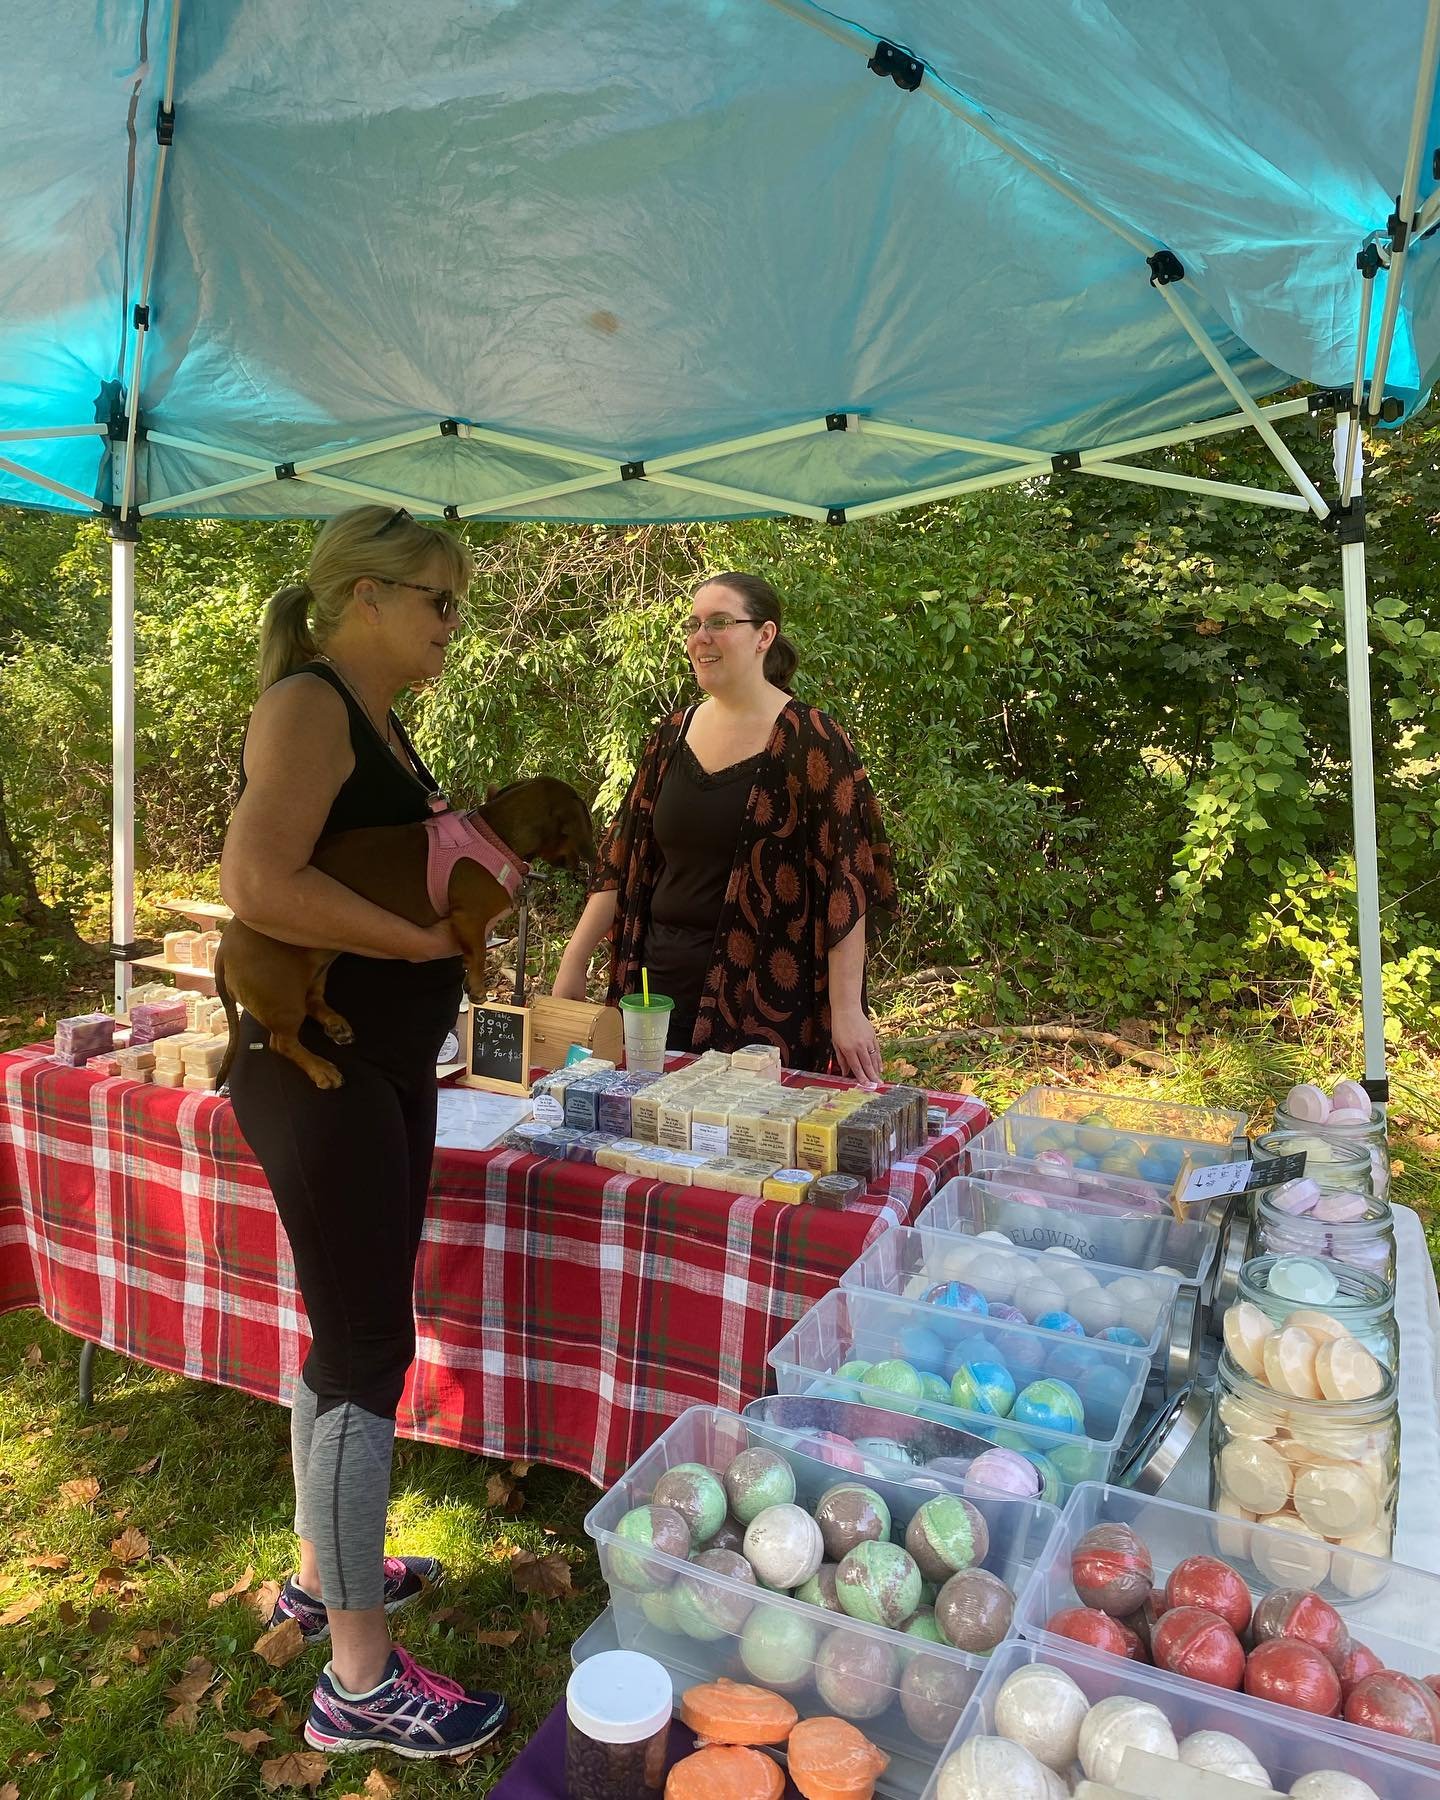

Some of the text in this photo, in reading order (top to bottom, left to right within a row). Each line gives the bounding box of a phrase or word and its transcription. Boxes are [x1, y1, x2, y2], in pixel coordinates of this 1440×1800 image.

[476, 1010, 509, 1032] Soap
[479, 1023, 493, 1037] $7
[493, 1048, 507, 1058] for
[1010, 1227, 1098, 1260] FLOWERS
